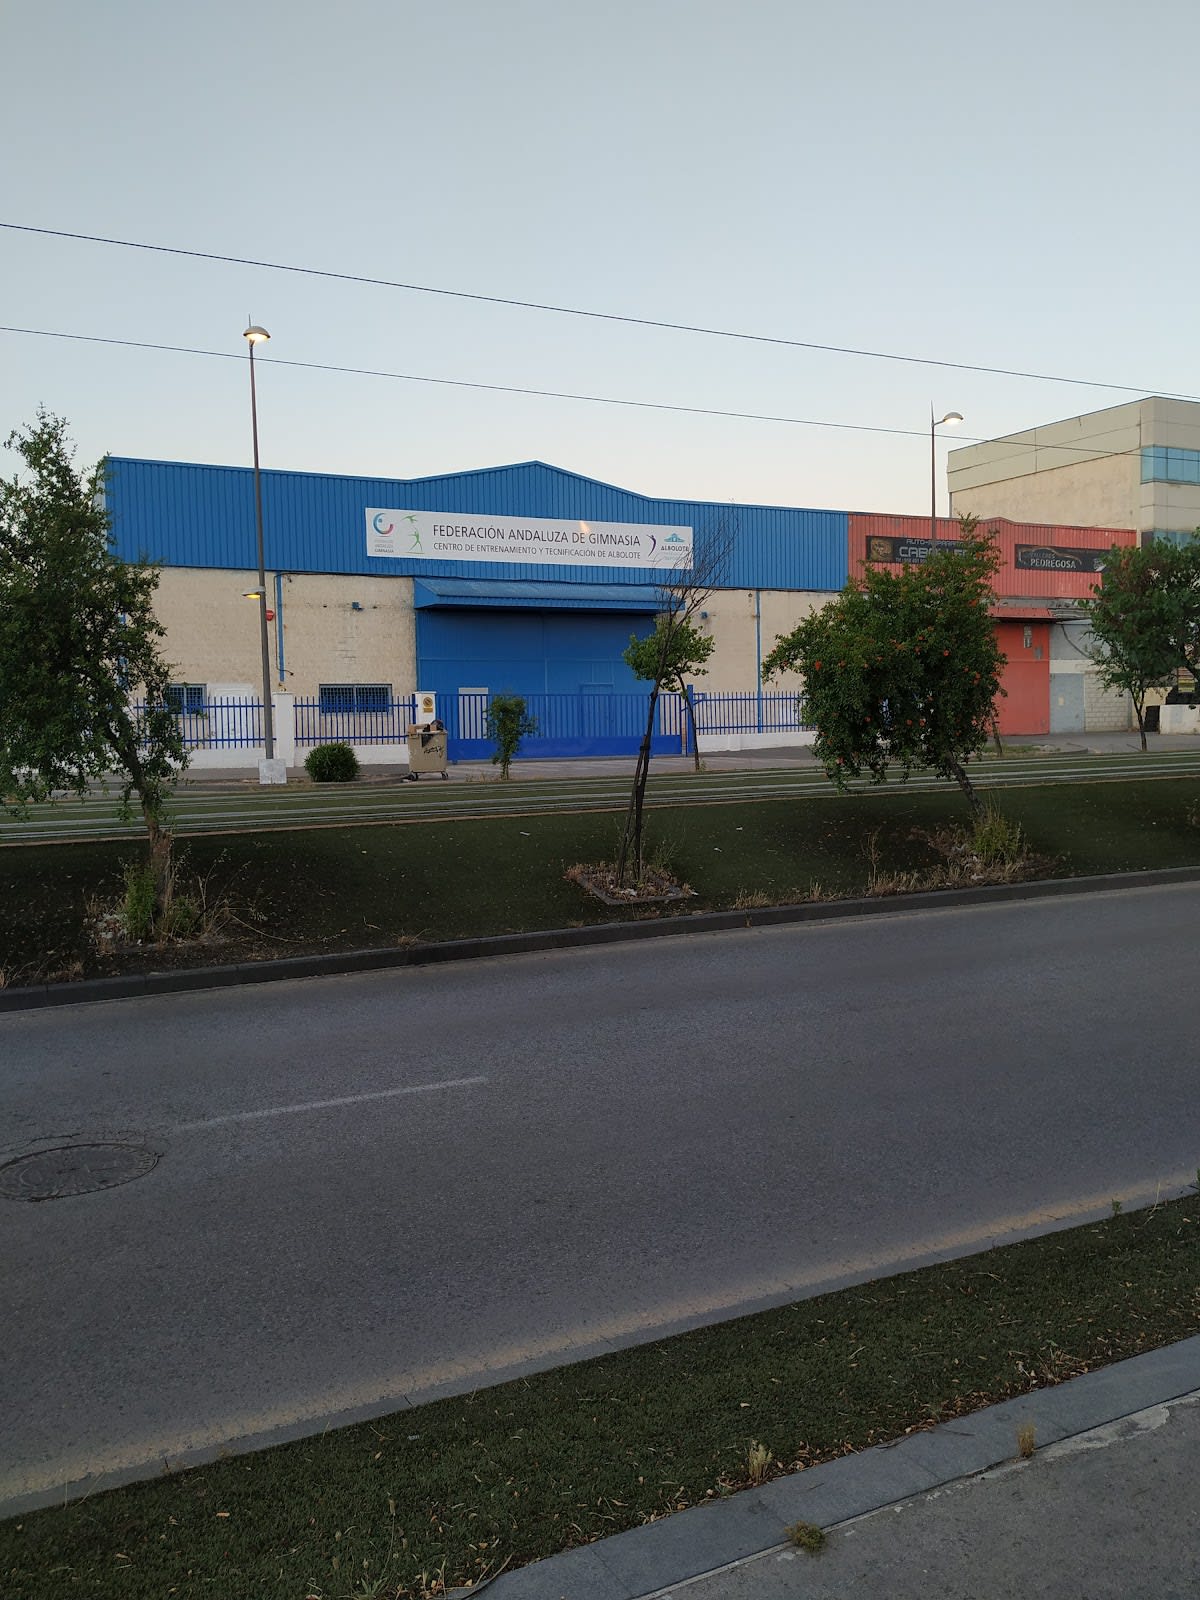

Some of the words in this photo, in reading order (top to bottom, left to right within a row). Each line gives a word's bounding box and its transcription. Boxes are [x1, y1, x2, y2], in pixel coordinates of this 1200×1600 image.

[433, 524, 505, 540] FEDERACIÓN
[508, 528, 569, 543] ANDALUZA
[572, 532, 586, 544] DE
[588, 533, 641, 547] GIMNASIA
[433, 542, 463, 552] CENTRO
[465, 544, 475, 552] DE
[476, 544, 537, 555] ENTRENAMIENTO
[538, 547, 544, 555] Y
[545, 547, 596, 558] TECNIFICACIÓN
[597, 550, 606, 558] DE
[608, 551, 641, 560] ALBOLOTE
[1030, 558, 1077, 569] PEDREGOSA
